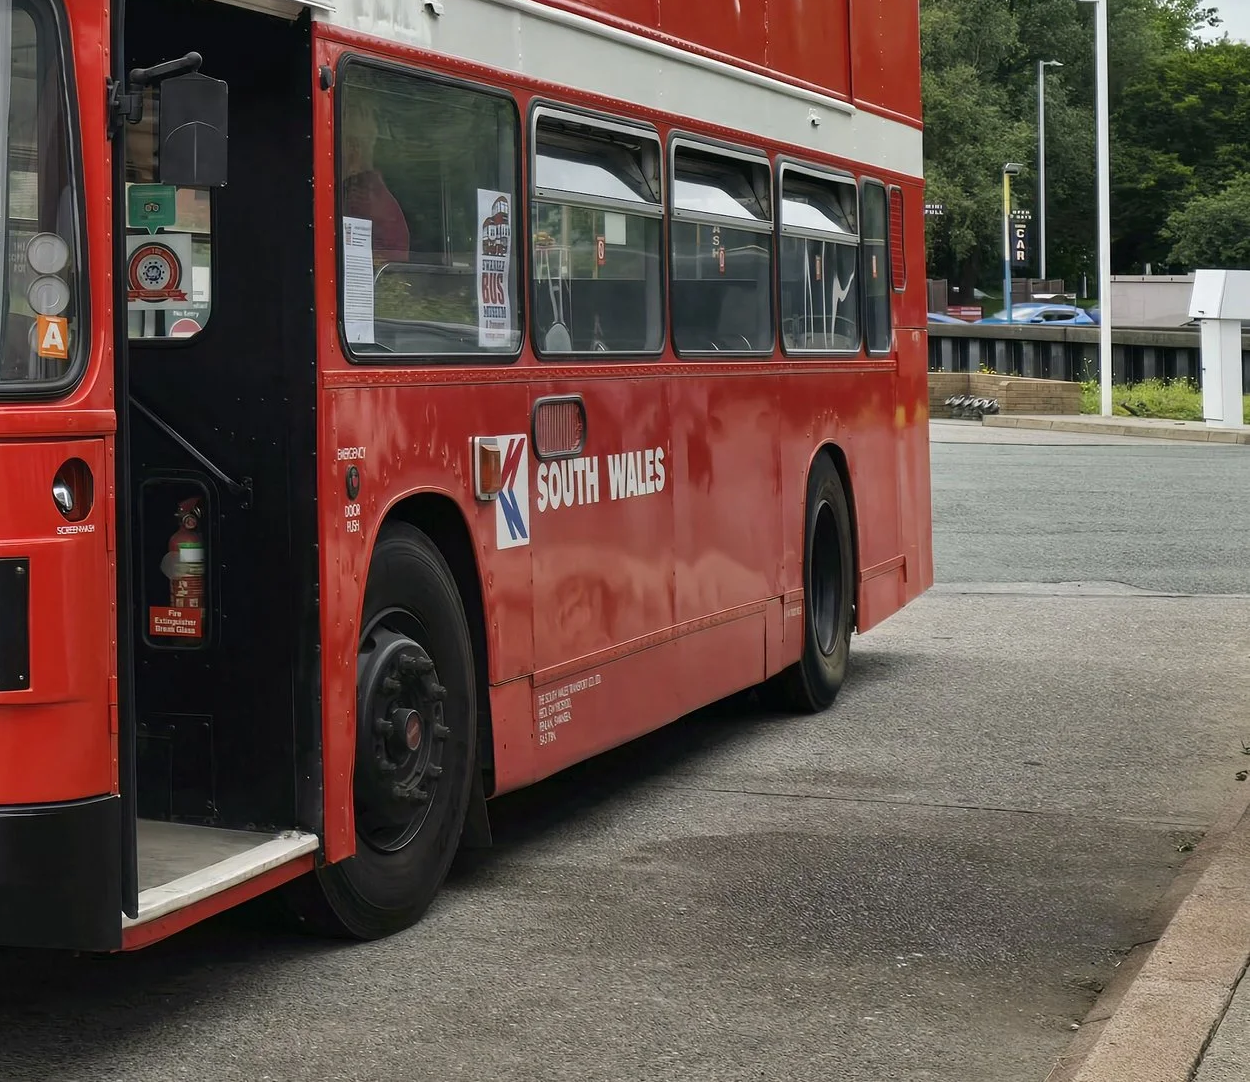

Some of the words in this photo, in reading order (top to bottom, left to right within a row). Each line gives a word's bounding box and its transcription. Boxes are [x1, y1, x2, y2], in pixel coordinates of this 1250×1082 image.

[1016, 228, 1025, 261] CAR
[481, 272, 505, 305] BUS
[41, 321, 65, 351] A
[337, 446, 367, 461] EMERGENCY
[536, 455, 600, 513] SOUTH
[607, 446, 666, 501] WALES
[344, 503, 361, 518] DOOR
[346, 519, 360, 533] PUSH
